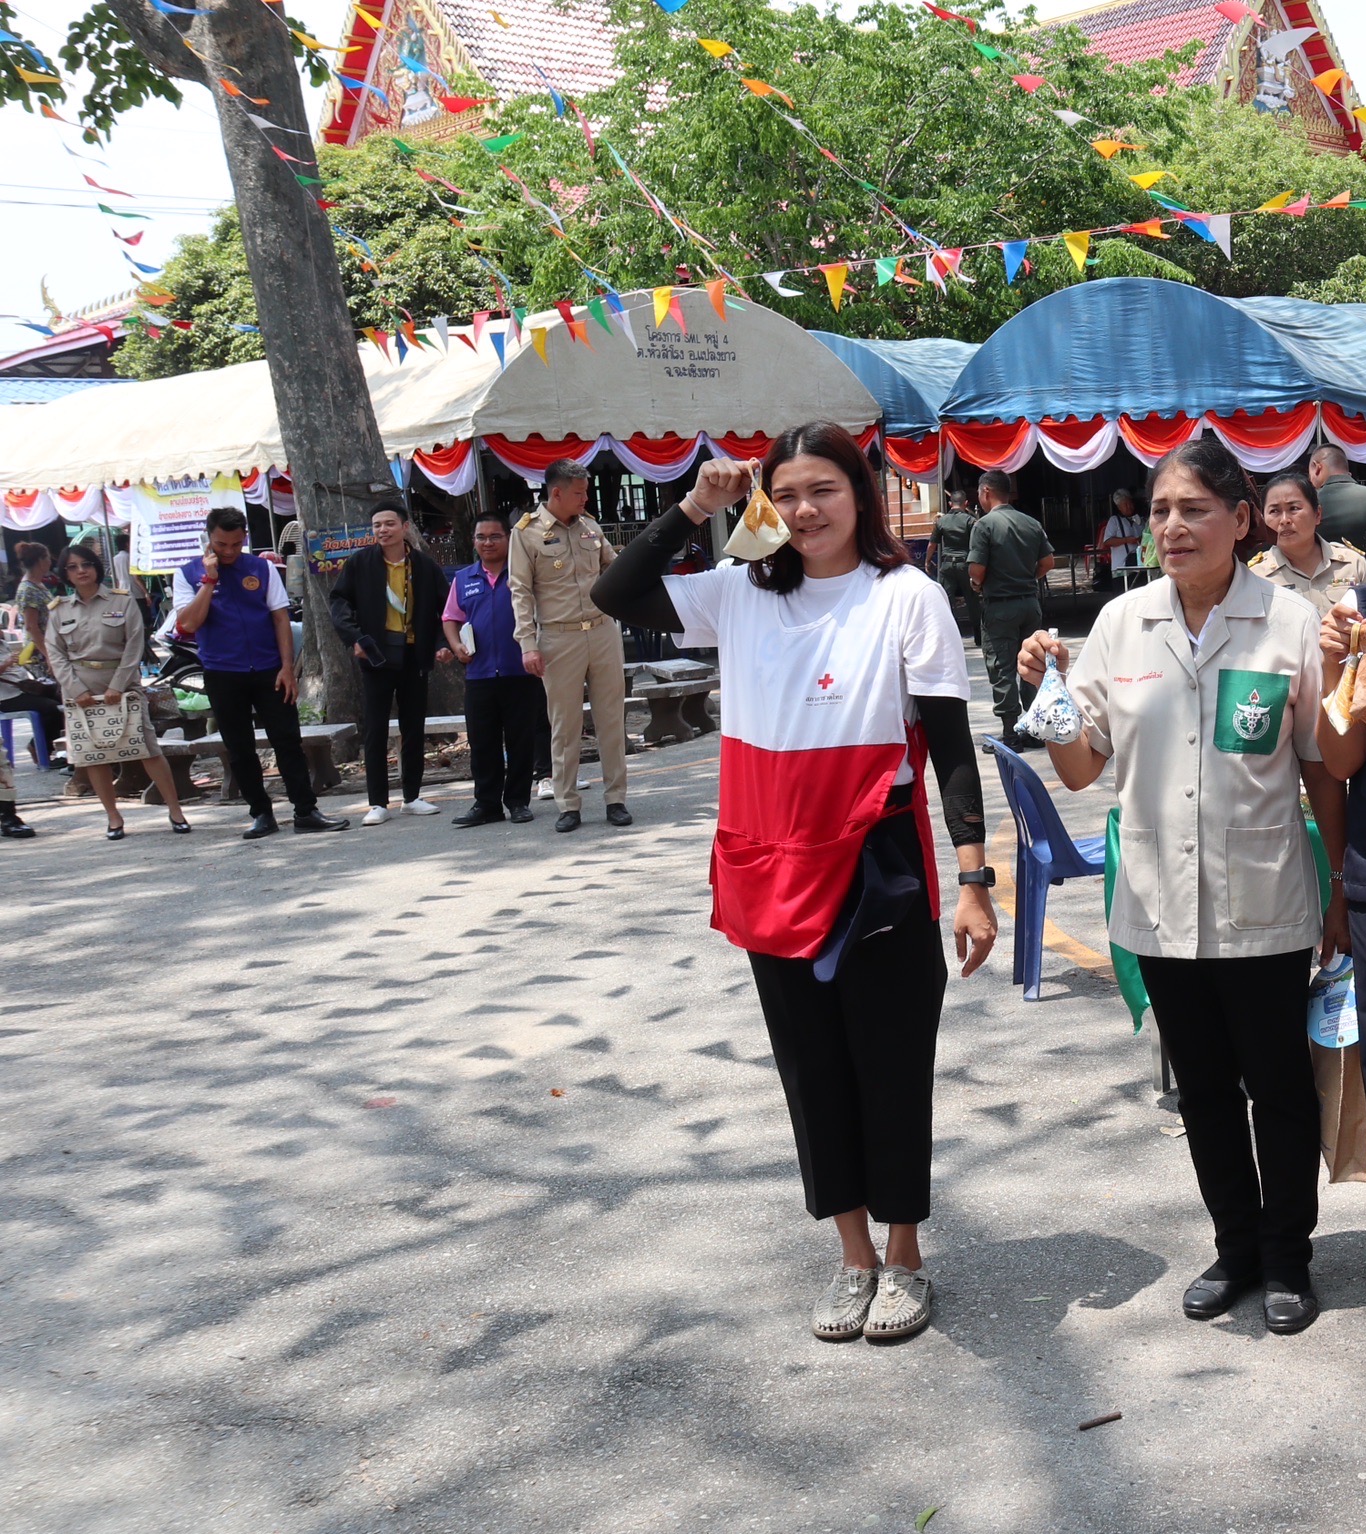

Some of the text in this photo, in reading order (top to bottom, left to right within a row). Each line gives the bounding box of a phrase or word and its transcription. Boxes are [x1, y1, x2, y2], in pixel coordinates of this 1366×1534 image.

[645, 325, 729, 349] โครงการ SML หมู่ 4
[664, 363, 720, 378] จ.ฉะเชิงเทรา
[85, 708, 106, 717] GLO
[85, 752, 106, 762] GLO
[118, 748, 140, 758] GLO
